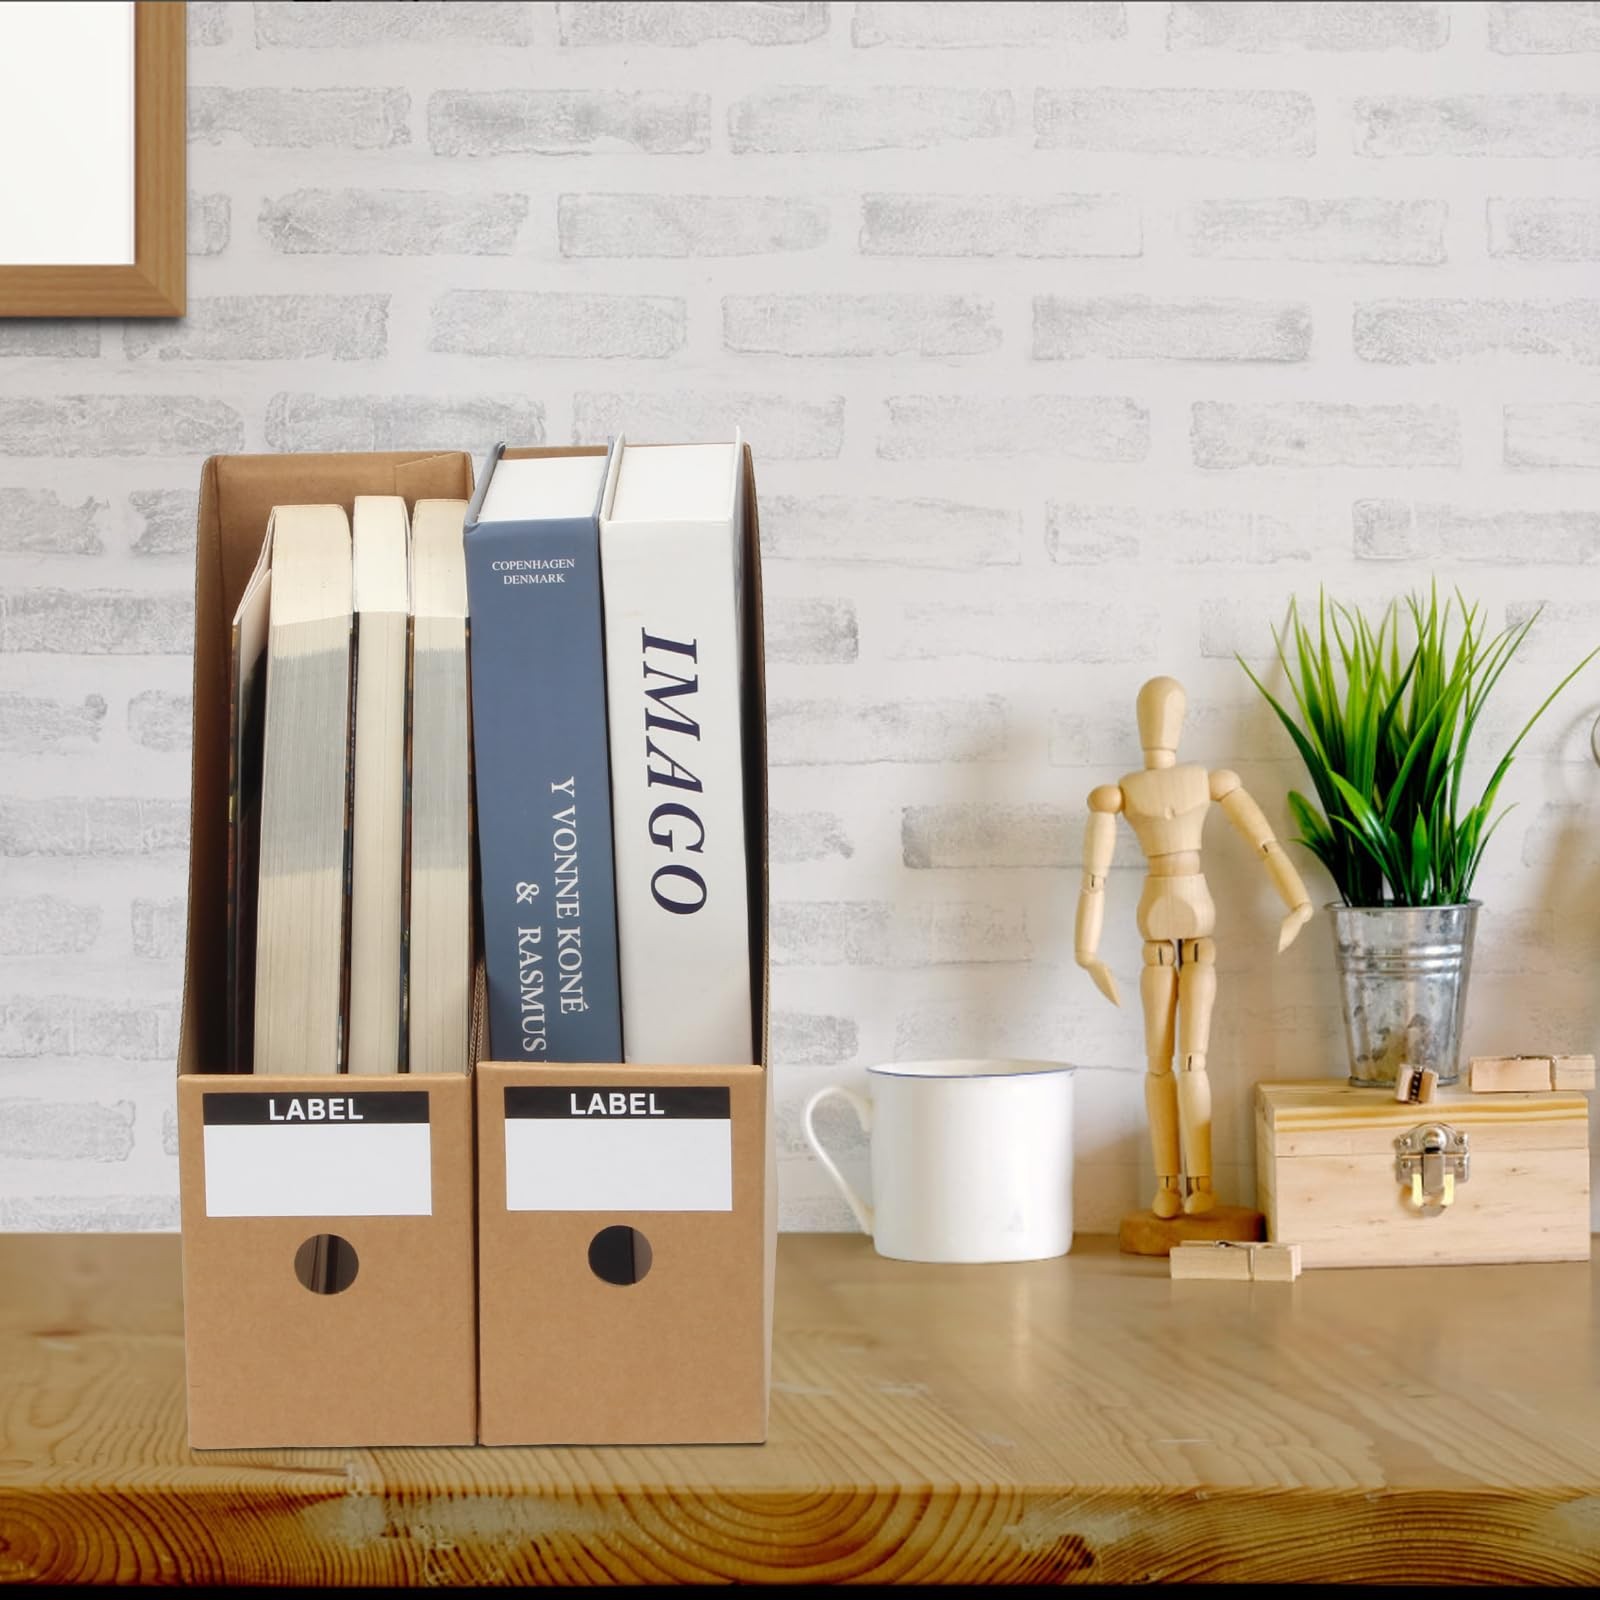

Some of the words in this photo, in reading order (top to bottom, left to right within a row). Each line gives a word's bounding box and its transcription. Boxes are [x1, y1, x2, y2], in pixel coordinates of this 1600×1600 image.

[491, 558, 575, 571] COPENHAGEN
[503, 573, 566, 585] DENMARK
[641, 627, 708, 915] IMAGO
[515, 881, 540, 905] &
[557, 926, 589, 1015] KONÉ
[517, 925, 547, 1052] RASMUS
[268, 1098, 364, 1121] LABEL
[570, 1092, 665, 1115] LABEL
